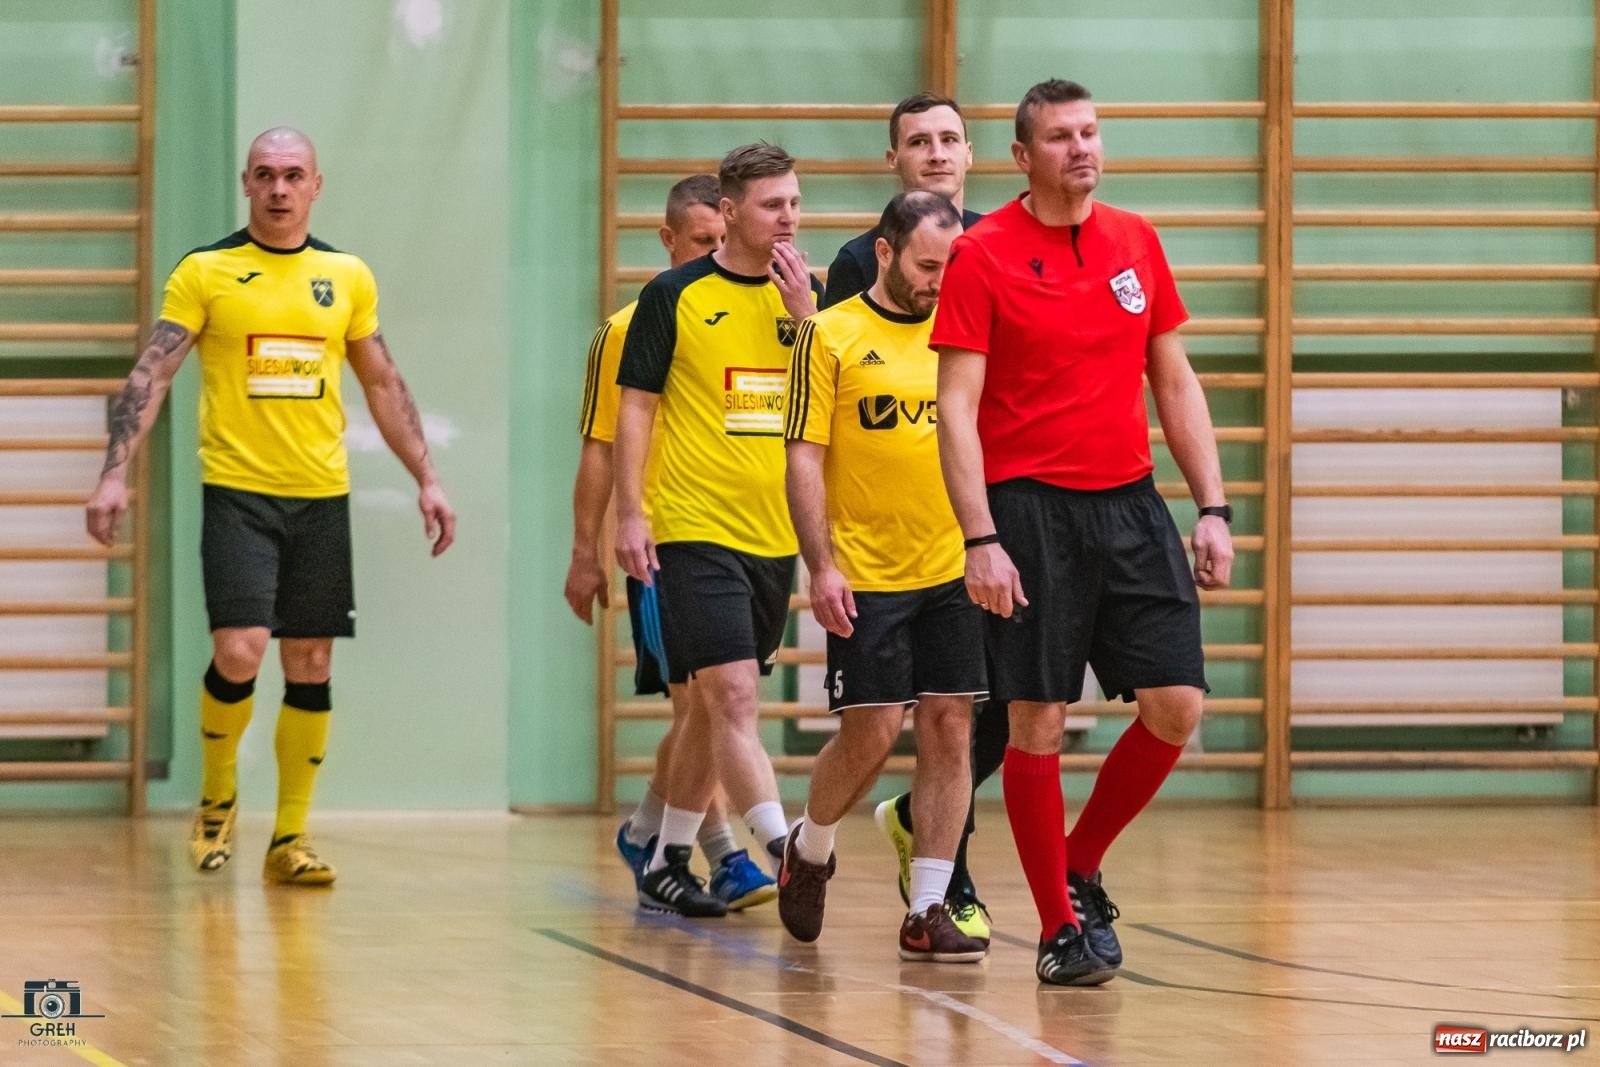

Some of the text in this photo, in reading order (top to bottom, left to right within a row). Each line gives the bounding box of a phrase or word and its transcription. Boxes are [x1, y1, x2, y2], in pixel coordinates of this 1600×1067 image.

[859, 359, 886, 367] adidas
[725, 393, 784, 411] SILESIAWO
[833, 670, 844, 699] 5
